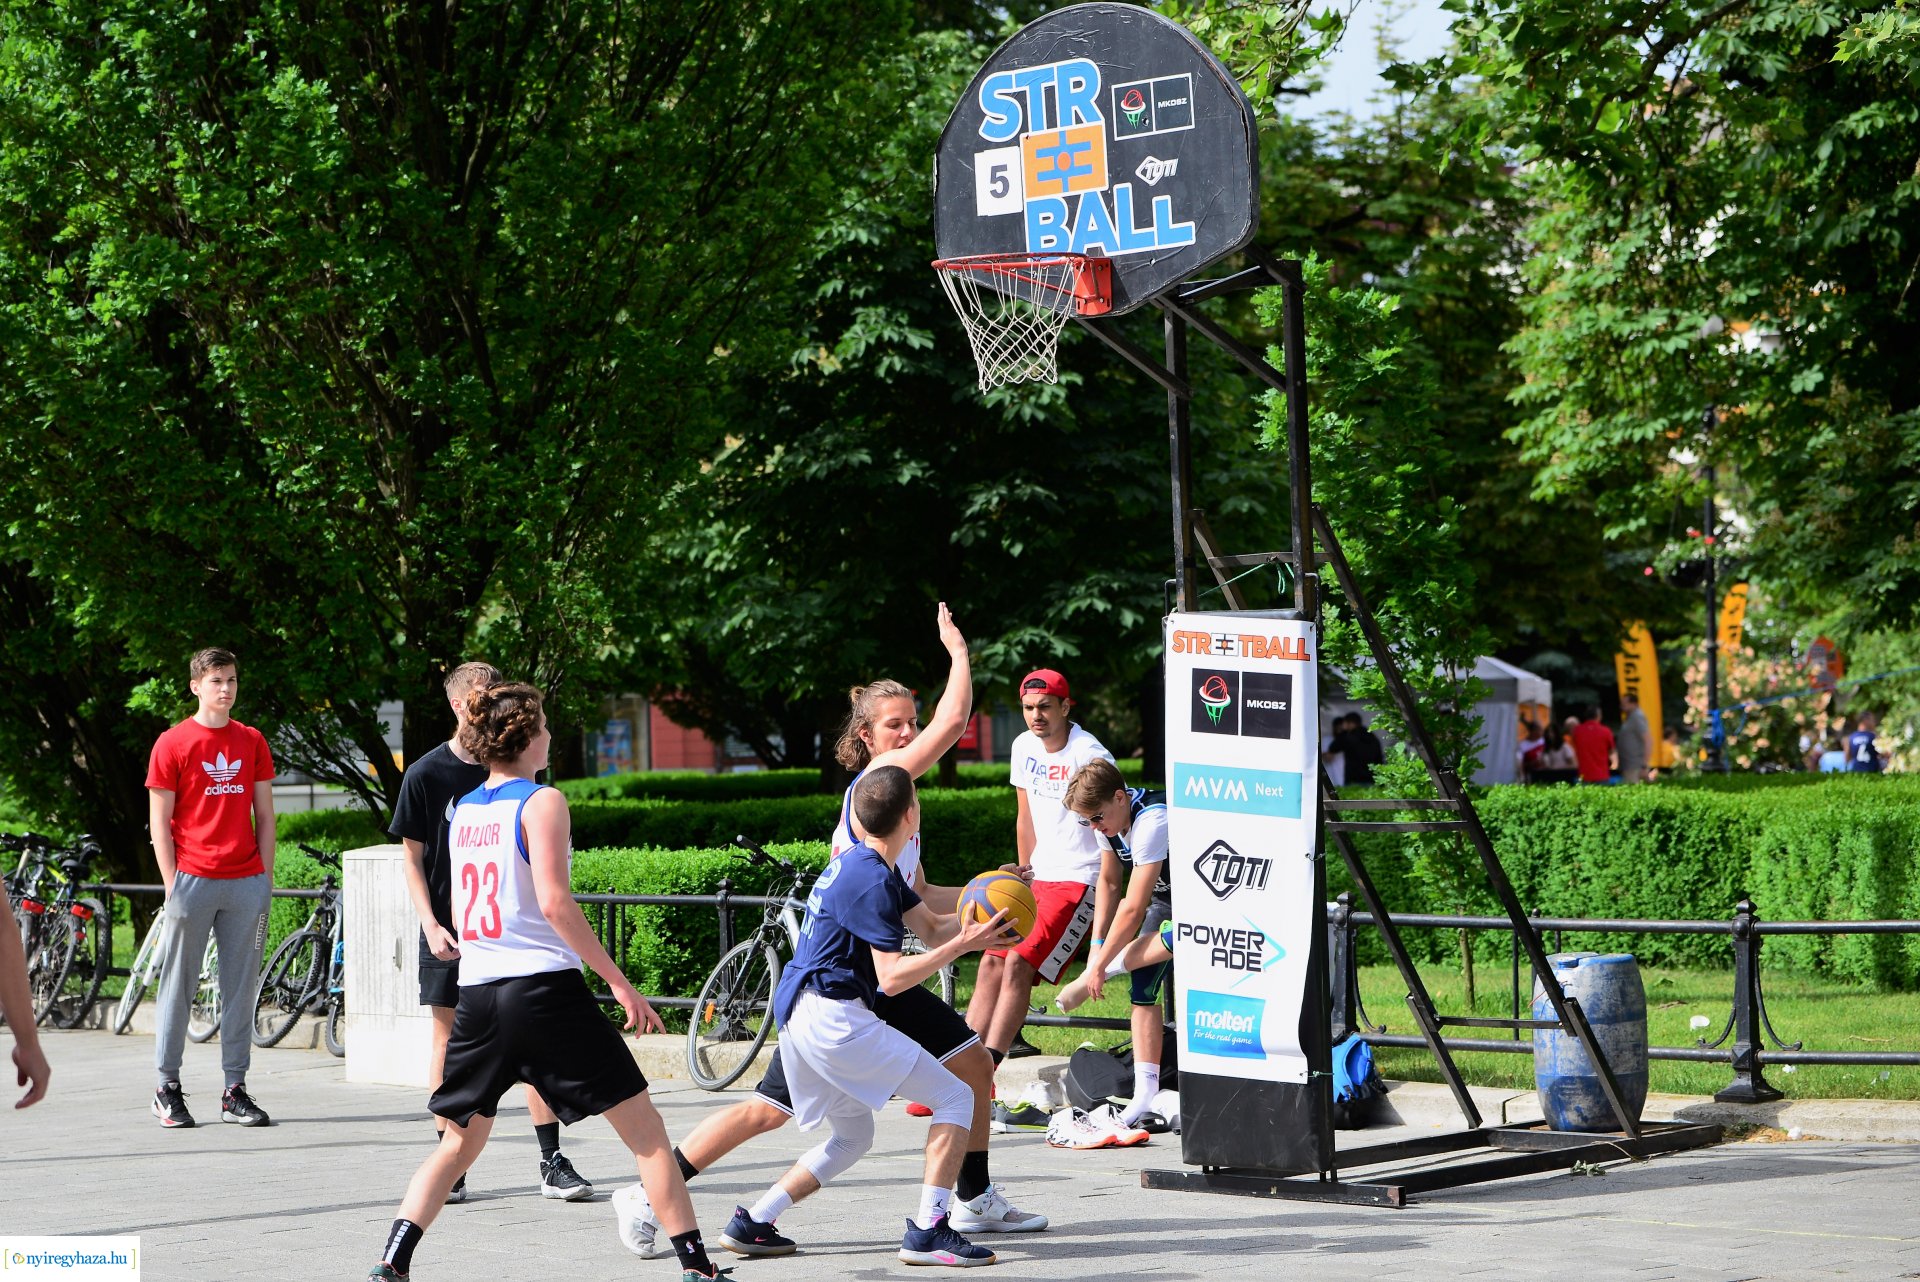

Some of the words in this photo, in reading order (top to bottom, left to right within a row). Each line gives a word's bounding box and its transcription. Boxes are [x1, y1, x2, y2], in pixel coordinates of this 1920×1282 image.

[989, 163, 1010, 199] 5
[1024, 183, 1196, 261] BALL
[1246, 699, 1287, 711] MKOSZ
[204, 783, 245, 796] adidas
[1185, 775, 1249, 802] MVM
[1255, 782, 1284, 798] Next
[457, 823, 501, 848] MAJOR
[1211, 853, 1273, 891] TOTI
[461, 861, 503, 941] 23
[1177, 923, 1265, 951] POWER
[1211, 947, 1262, 973] ADE
[1194, 1010, 1253, 1034] molten
[1193, 1029, 1204, 1039] For
[1204, 1031, 1216, 1041] the
[1216, 1034, 1232, 1043] real
[1231, 1037, 1253, 1046] game
